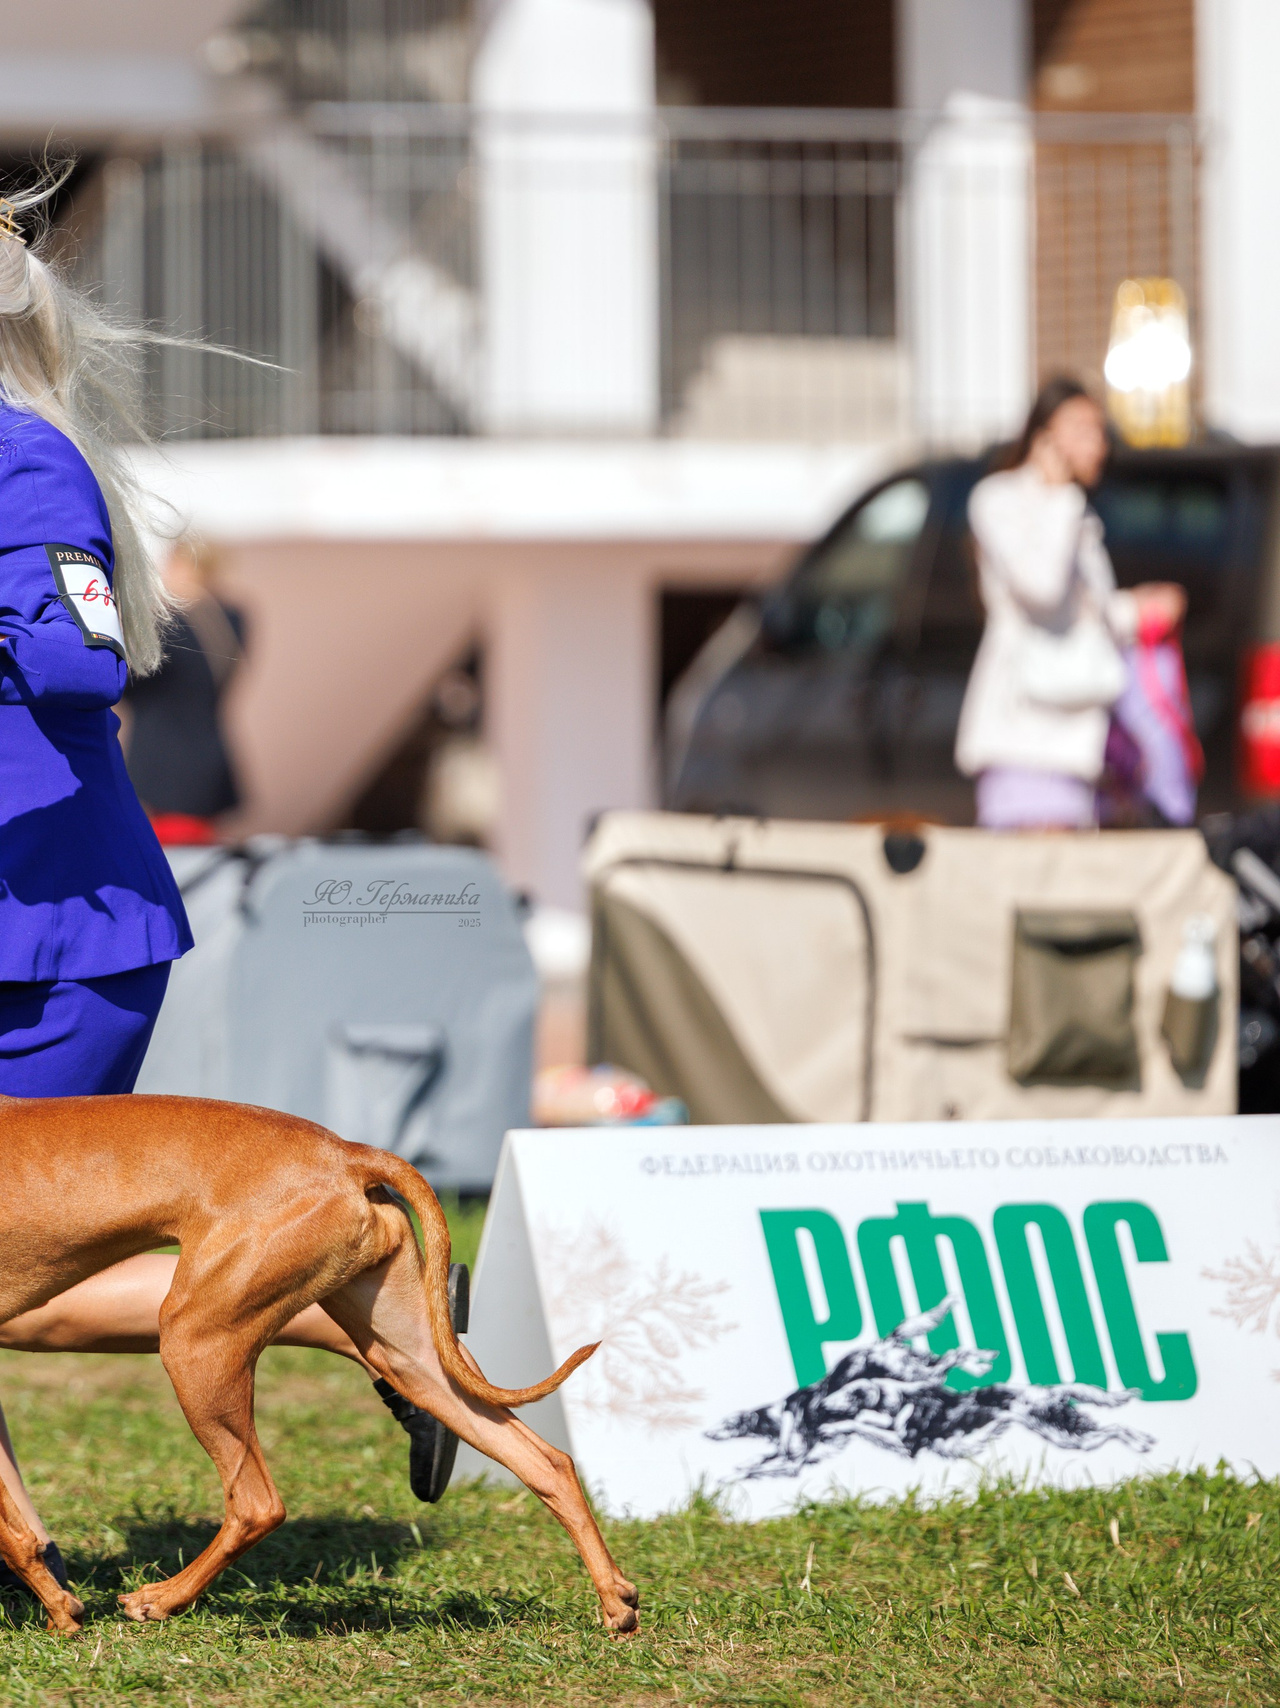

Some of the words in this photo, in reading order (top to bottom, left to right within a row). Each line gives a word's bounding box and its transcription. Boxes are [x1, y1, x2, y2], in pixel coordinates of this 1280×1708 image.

[638, 1152, 801, 1177] ФЕДЕРАЦИЯ
[806, 1147, 1000, 1173] ОХОТНИЧЬЕГО
[1005, 1142, 1229, 1169] СОБАКОВОДСТВА
[759, 1201, 1198, 1405] РФОС
